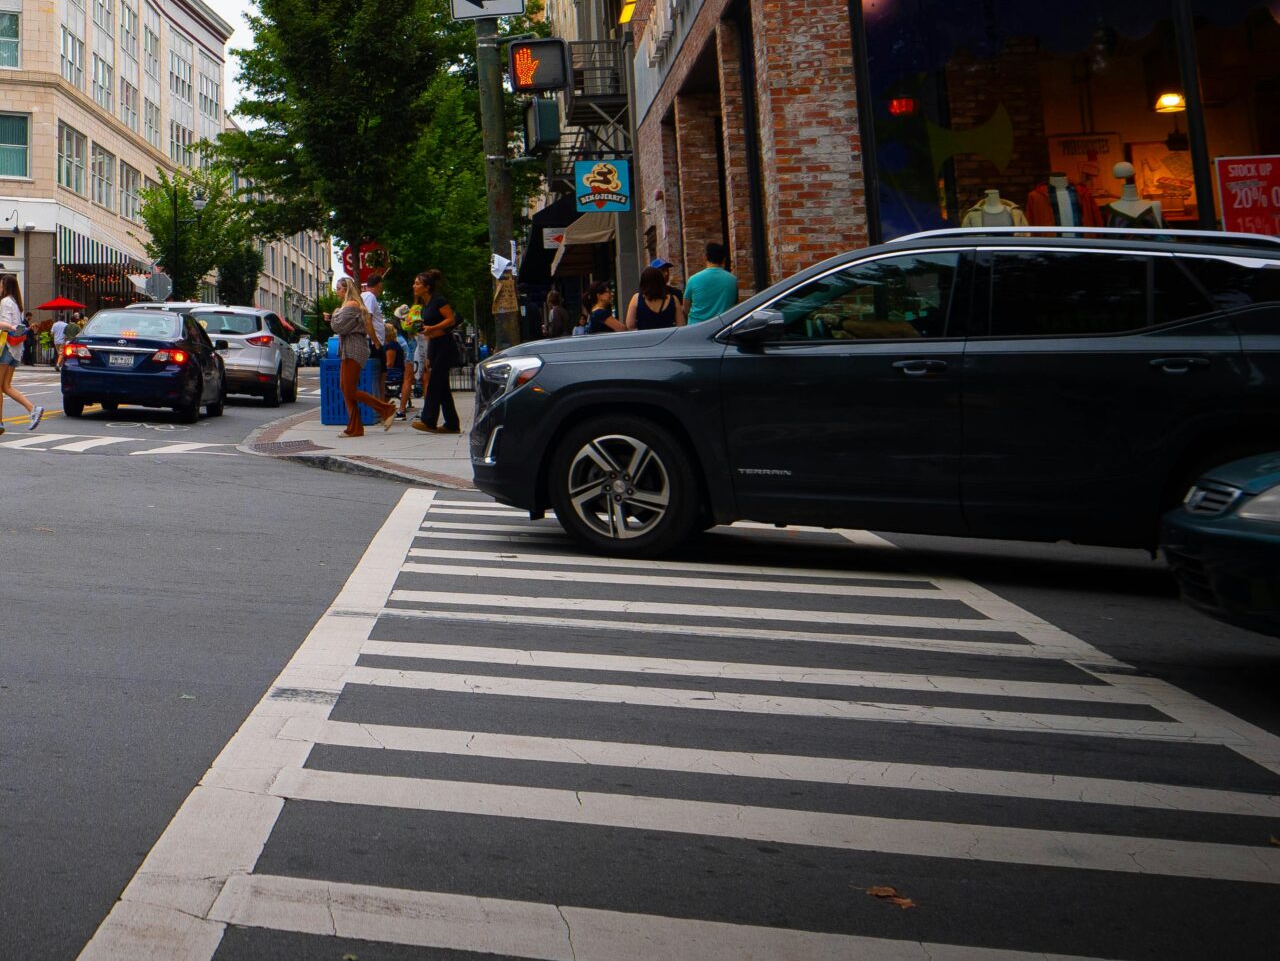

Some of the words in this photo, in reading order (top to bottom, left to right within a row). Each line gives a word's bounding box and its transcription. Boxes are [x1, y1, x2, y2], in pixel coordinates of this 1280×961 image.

[1227, 164, 1258, 177] STOCK
[1259, 163, 1273, 176] UP
[1231, 187, 1268, 208] 20%
[737, 467, 792, 476] TERRAIN
